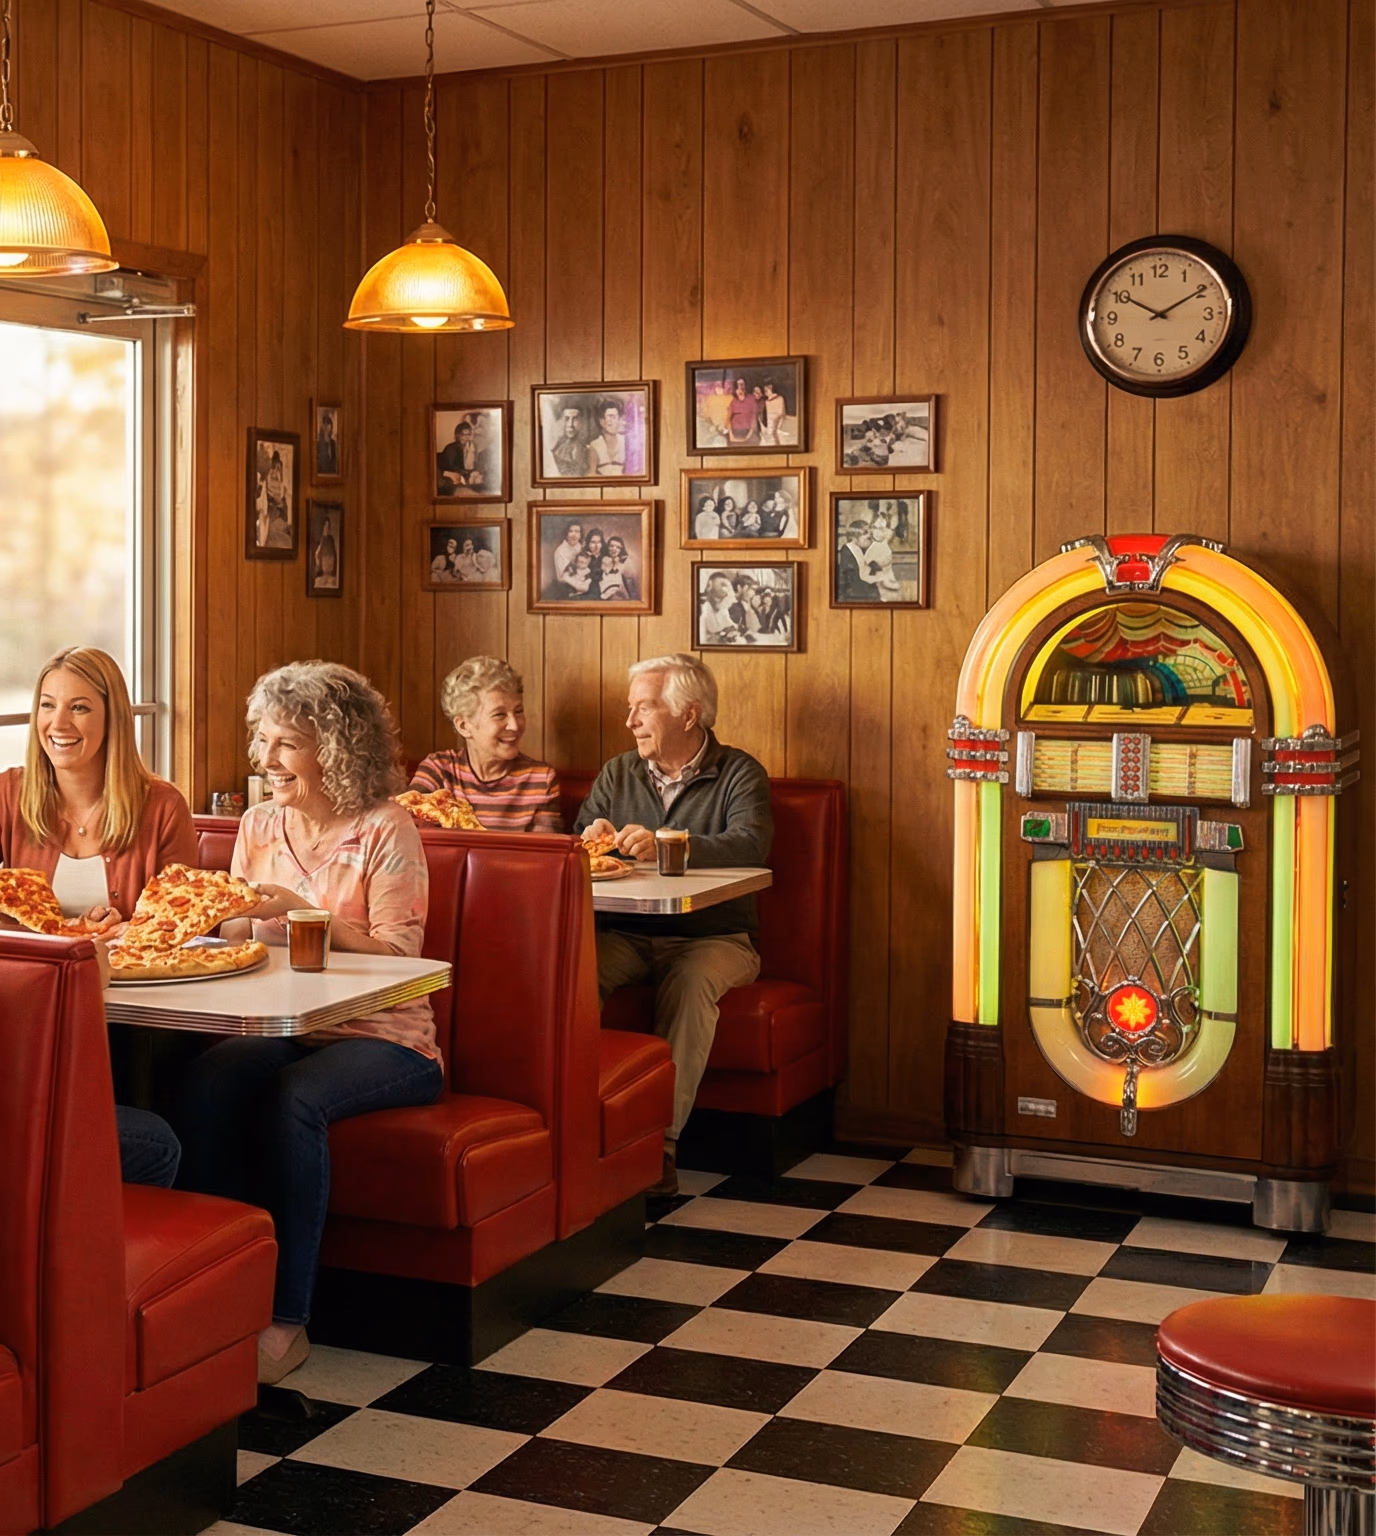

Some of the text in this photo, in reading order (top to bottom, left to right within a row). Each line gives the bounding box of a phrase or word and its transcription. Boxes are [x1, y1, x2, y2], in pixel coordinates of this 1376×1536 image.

[1151, 264, 1169, 278] 12
[1181, 269, 1187, 283] 1
[1129, 273, 1144, 286] 11
[1112, 290, 1131, 304] 10
[1196, 284, 1207, 299] 2
[1107, 311, 1118, 325] 9
[1203, 307, 1214, 321] 3
[1114, 333, 1125, 348] 8
[1195, 329, 1206, 343] 4
[1132, 347, 1143, 362] 7
[1153, 352, 1165, 367] 6
[1178, 345, 1189, 360] 5
